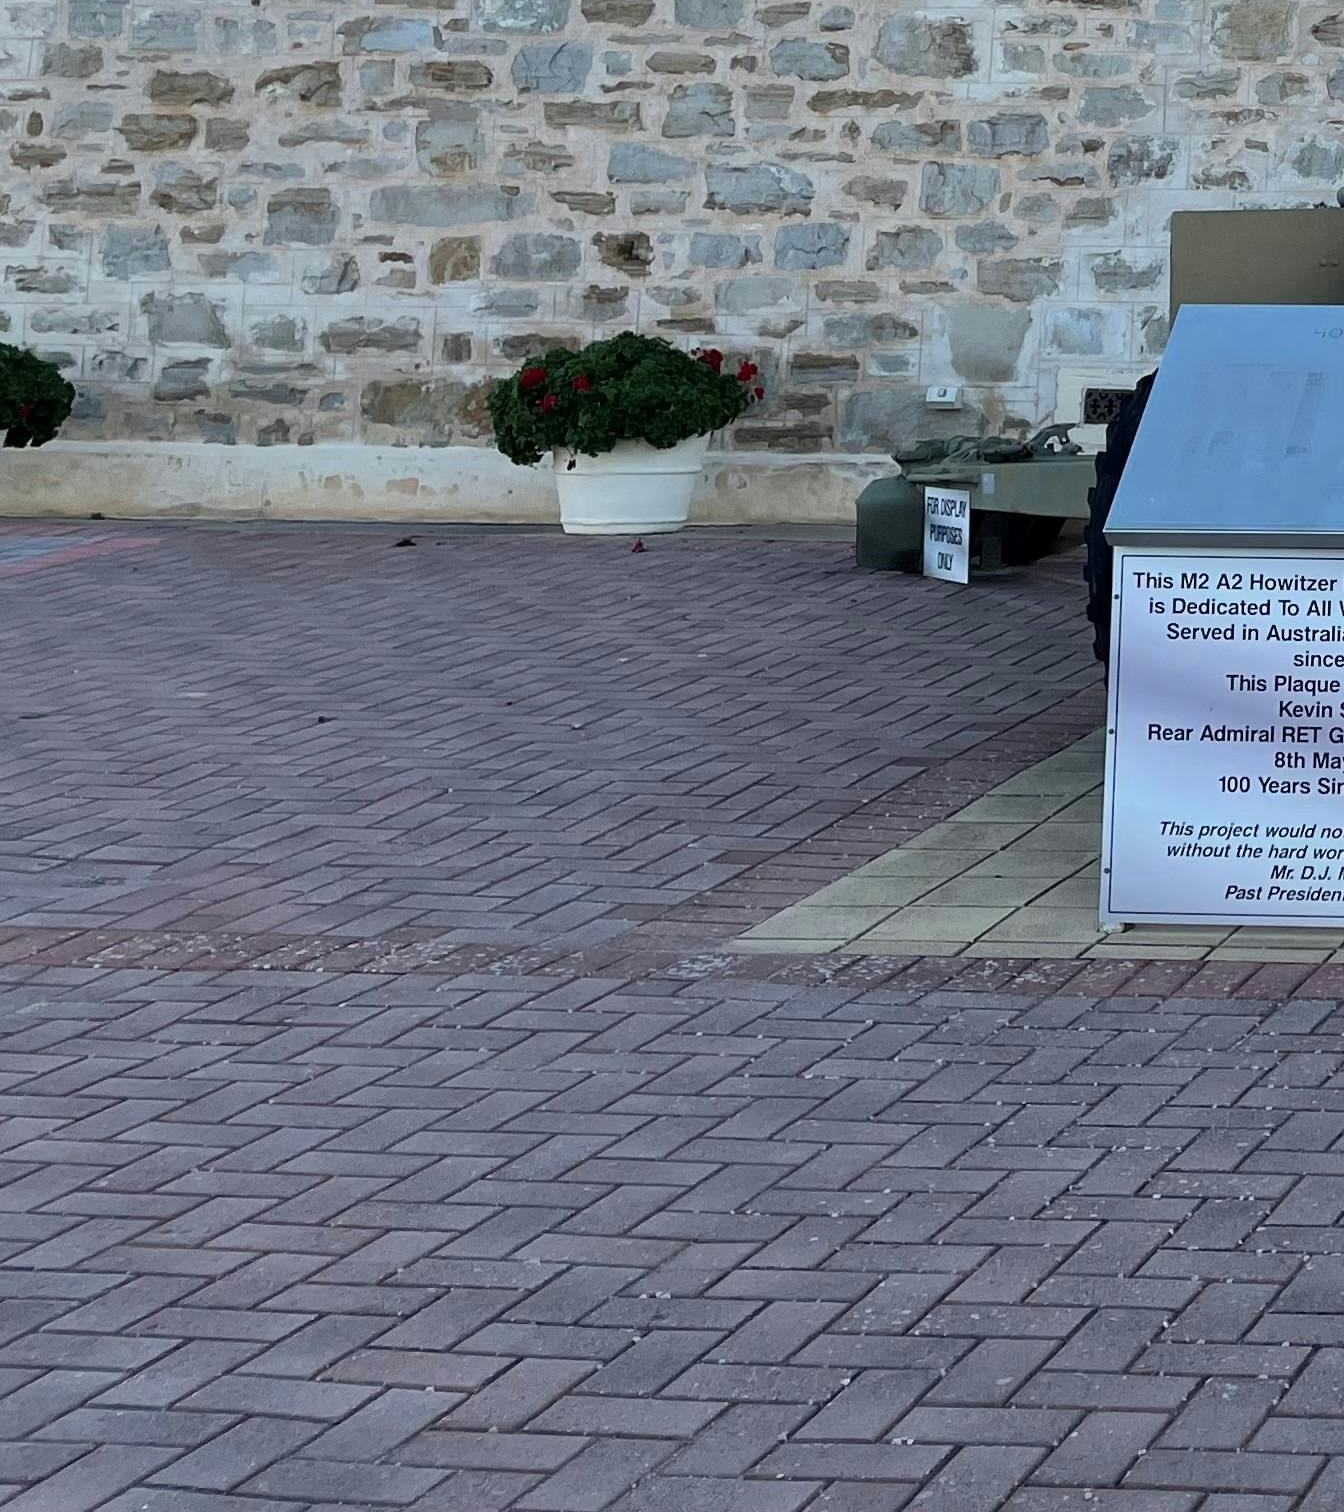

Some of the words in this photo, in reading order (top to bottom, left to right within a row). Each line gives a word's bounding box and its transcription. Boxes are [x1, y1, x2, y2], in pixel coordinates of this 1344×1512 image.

[927, 497, 939, 516] FOR
[940, 498, 967, 518] DISPLAY
[929, 523, 963, 546] PURPOSES
[937, 552, 954, 571] ONLY
[1132, 572, 1174, 589] This
[1181, 572, 1209, 590] M2
[1216, 573, 1243, 590] A2
[1250, 573, 1338, 592] Howitzer
[1149, 597, 1165, 614] is
[1172, 598, 1271, 616] Dedicated
[1278, 599, 1300, 616] To
[1306, 600, 1332, 617] All
[1166, 622, 1235, 640] Served
[1242, 624, 1259, 641] in
[1226, 674, 1267, 692] This
[1274, 675, 1341, 697] Plaque
[1279, 700, 1333, 718] Kevin
[1148, 724, 1194, 741] Rear
[1200, 724, 1275, 743] Admiral
[1282, 726, 1323, 743] RET
[1274, 751, 1305, 769] 8th
[1218, 776, 1250, 793] 100
[1258, 776, 1311, 794] Years
[1160, 821, 1194, 836] This
[1197, 822, 1260, 841] project
[1266, 823, 1317, 839] would
[1167, 842, 1231, 858] without
[1236, 843, 1263, 858] the
[1268, 844, 1309, 859] hard
[1270, 865, 1294, 880] Mr.
[1300, 865, 1331, 881] D.J.
[1225, 885, 1263, 900] Past
